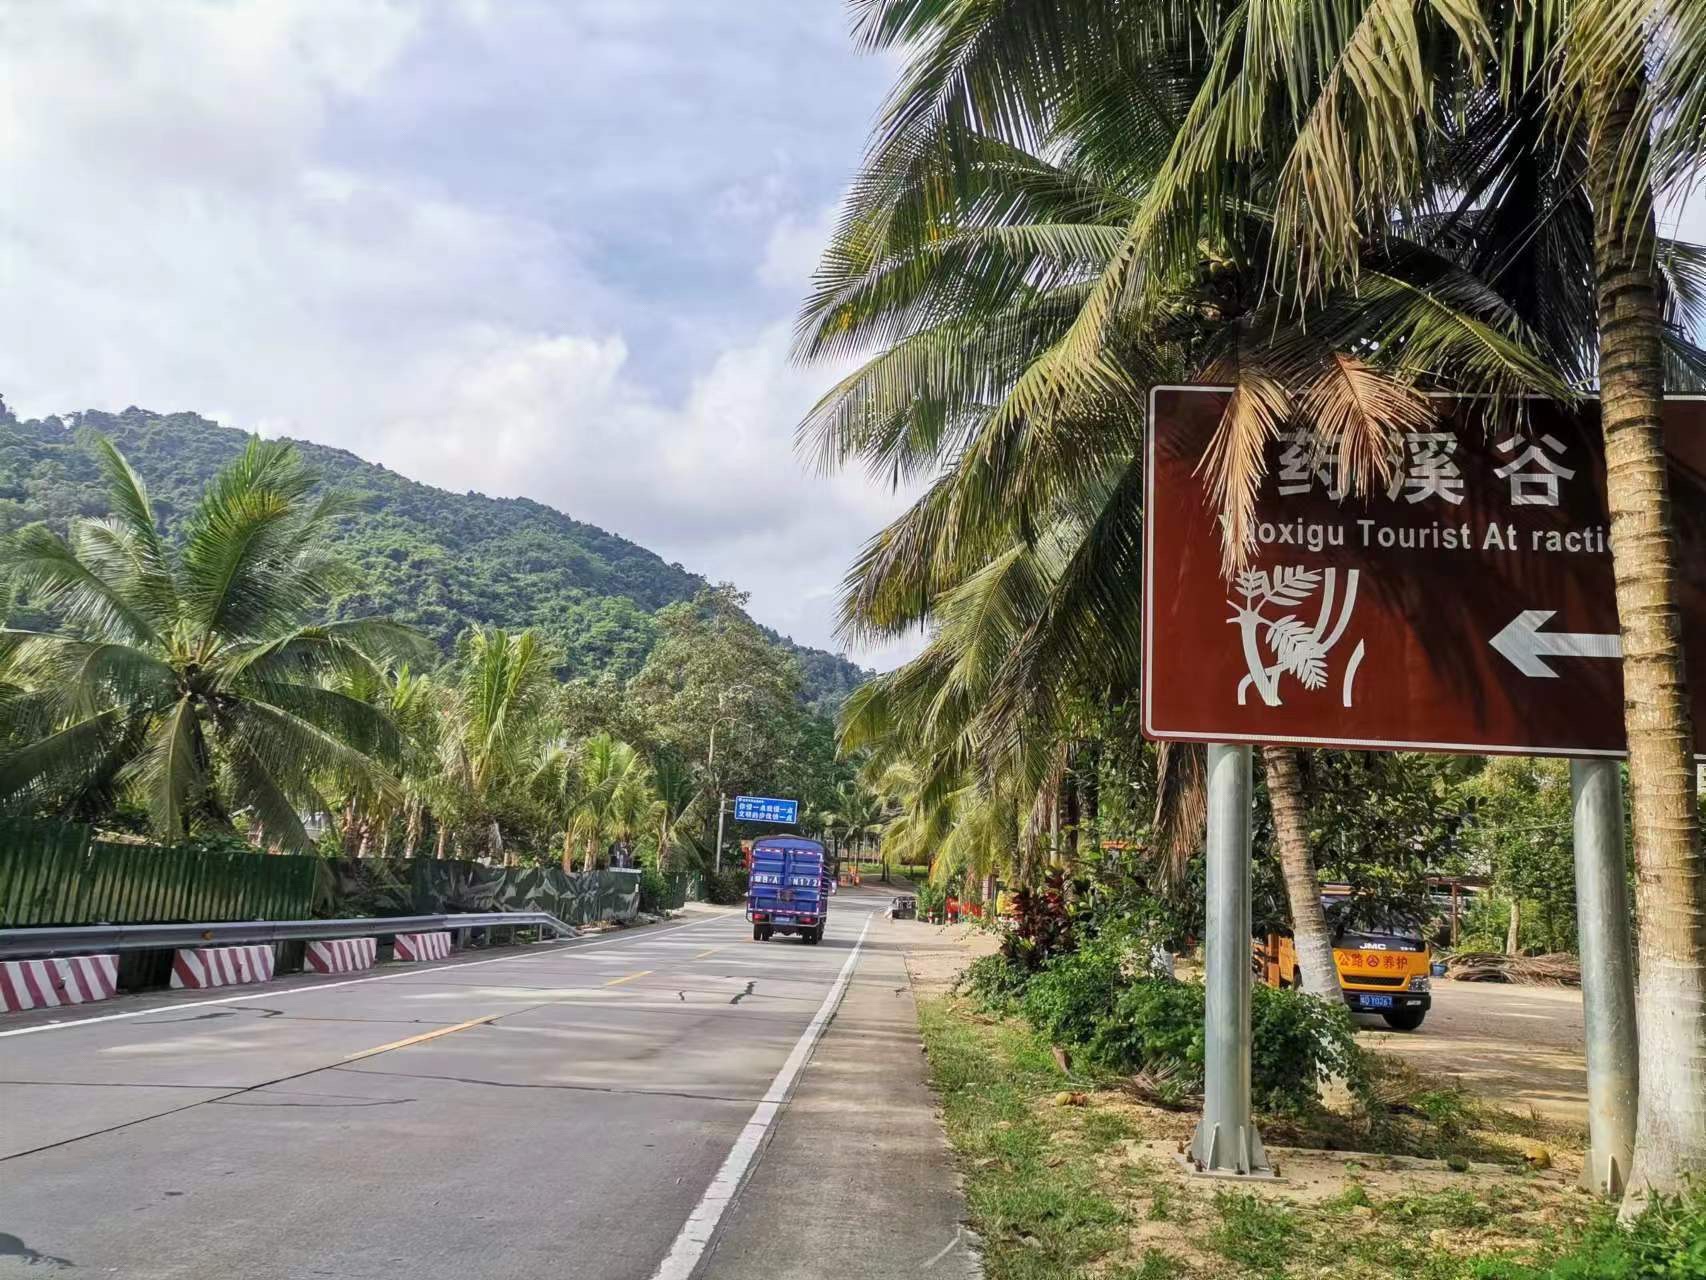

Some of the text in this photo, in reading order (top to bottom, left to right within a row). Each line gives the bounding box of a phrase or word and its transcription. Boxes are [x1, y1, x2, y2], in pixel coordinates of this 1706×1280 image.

[1278, 430, 1575, 506] 药溪谷
[1218, 515, 1343, 552] oxigu
[1357, 519, 1471, 549] Tourist
[1533, 525, 1612, 553] racti
